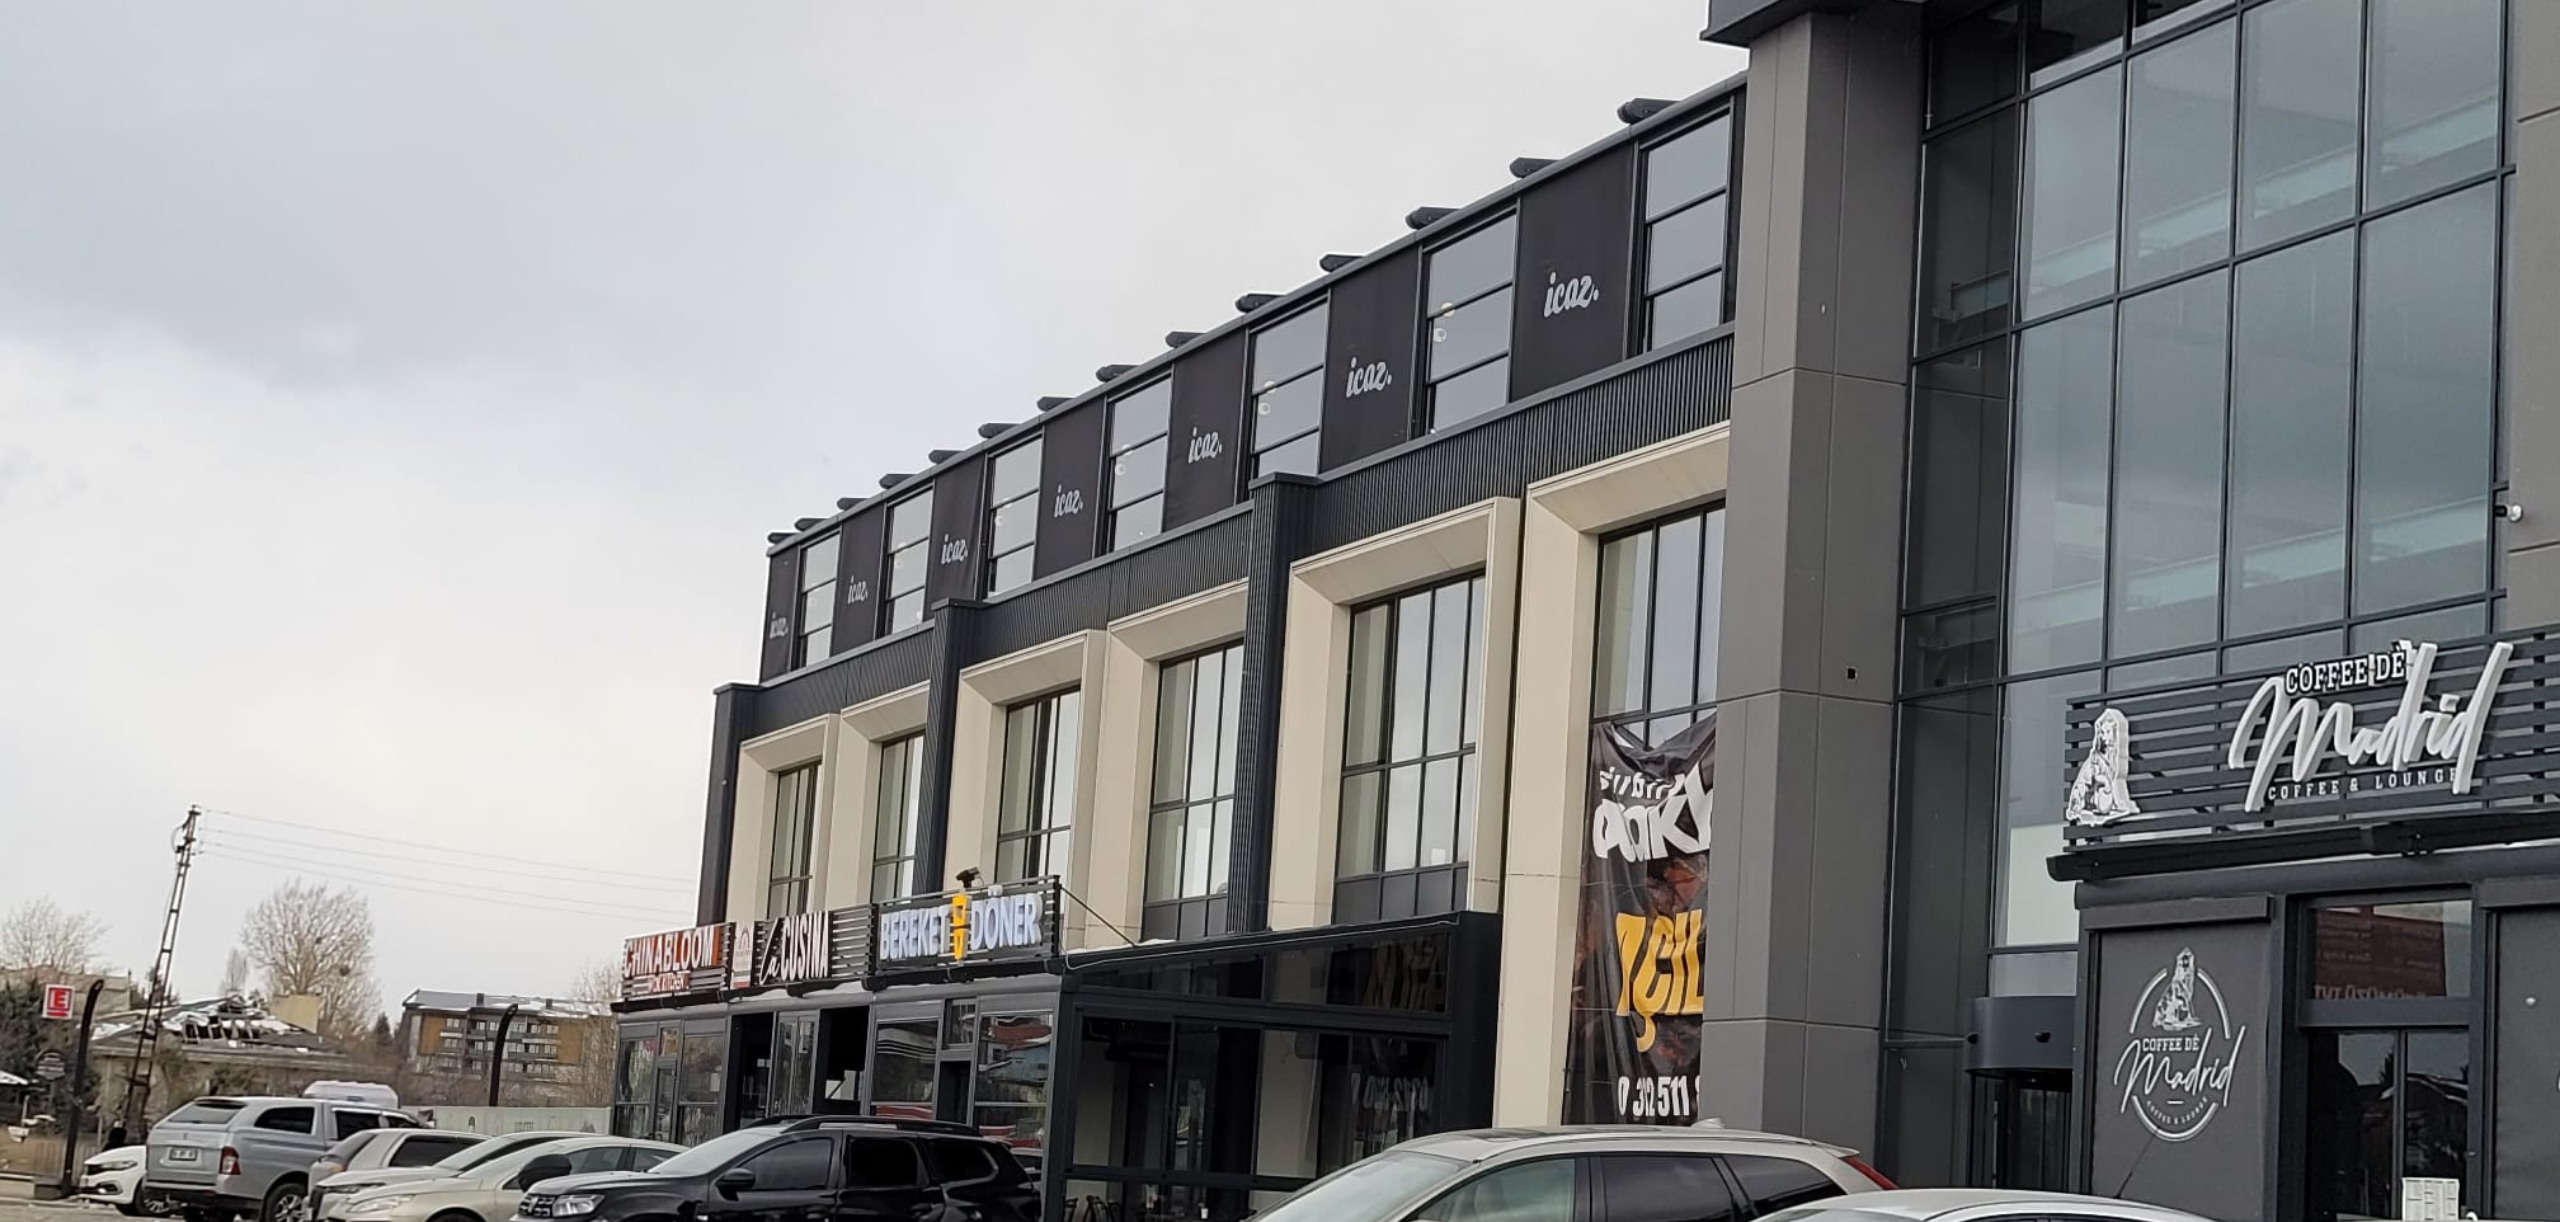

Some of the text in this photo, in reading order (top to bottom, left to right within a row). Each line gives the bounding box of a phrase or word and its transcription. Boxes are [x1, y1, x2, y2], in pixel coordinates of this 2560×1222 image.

[2285, 656, 2368, 694] COFFEE
[2228, 641, 2514, 813] Madrid
[2268, 768, 2457, 801] COFFEE & LOUNGE
[879, 885, 1042, 961] BEREKET DÖNER
[623, 925, 715, 980] CHINABLOOM
[2113, 1025, 2246, 1114] Madrid
[2142, 1037, 2183, 1052] COFFEE
